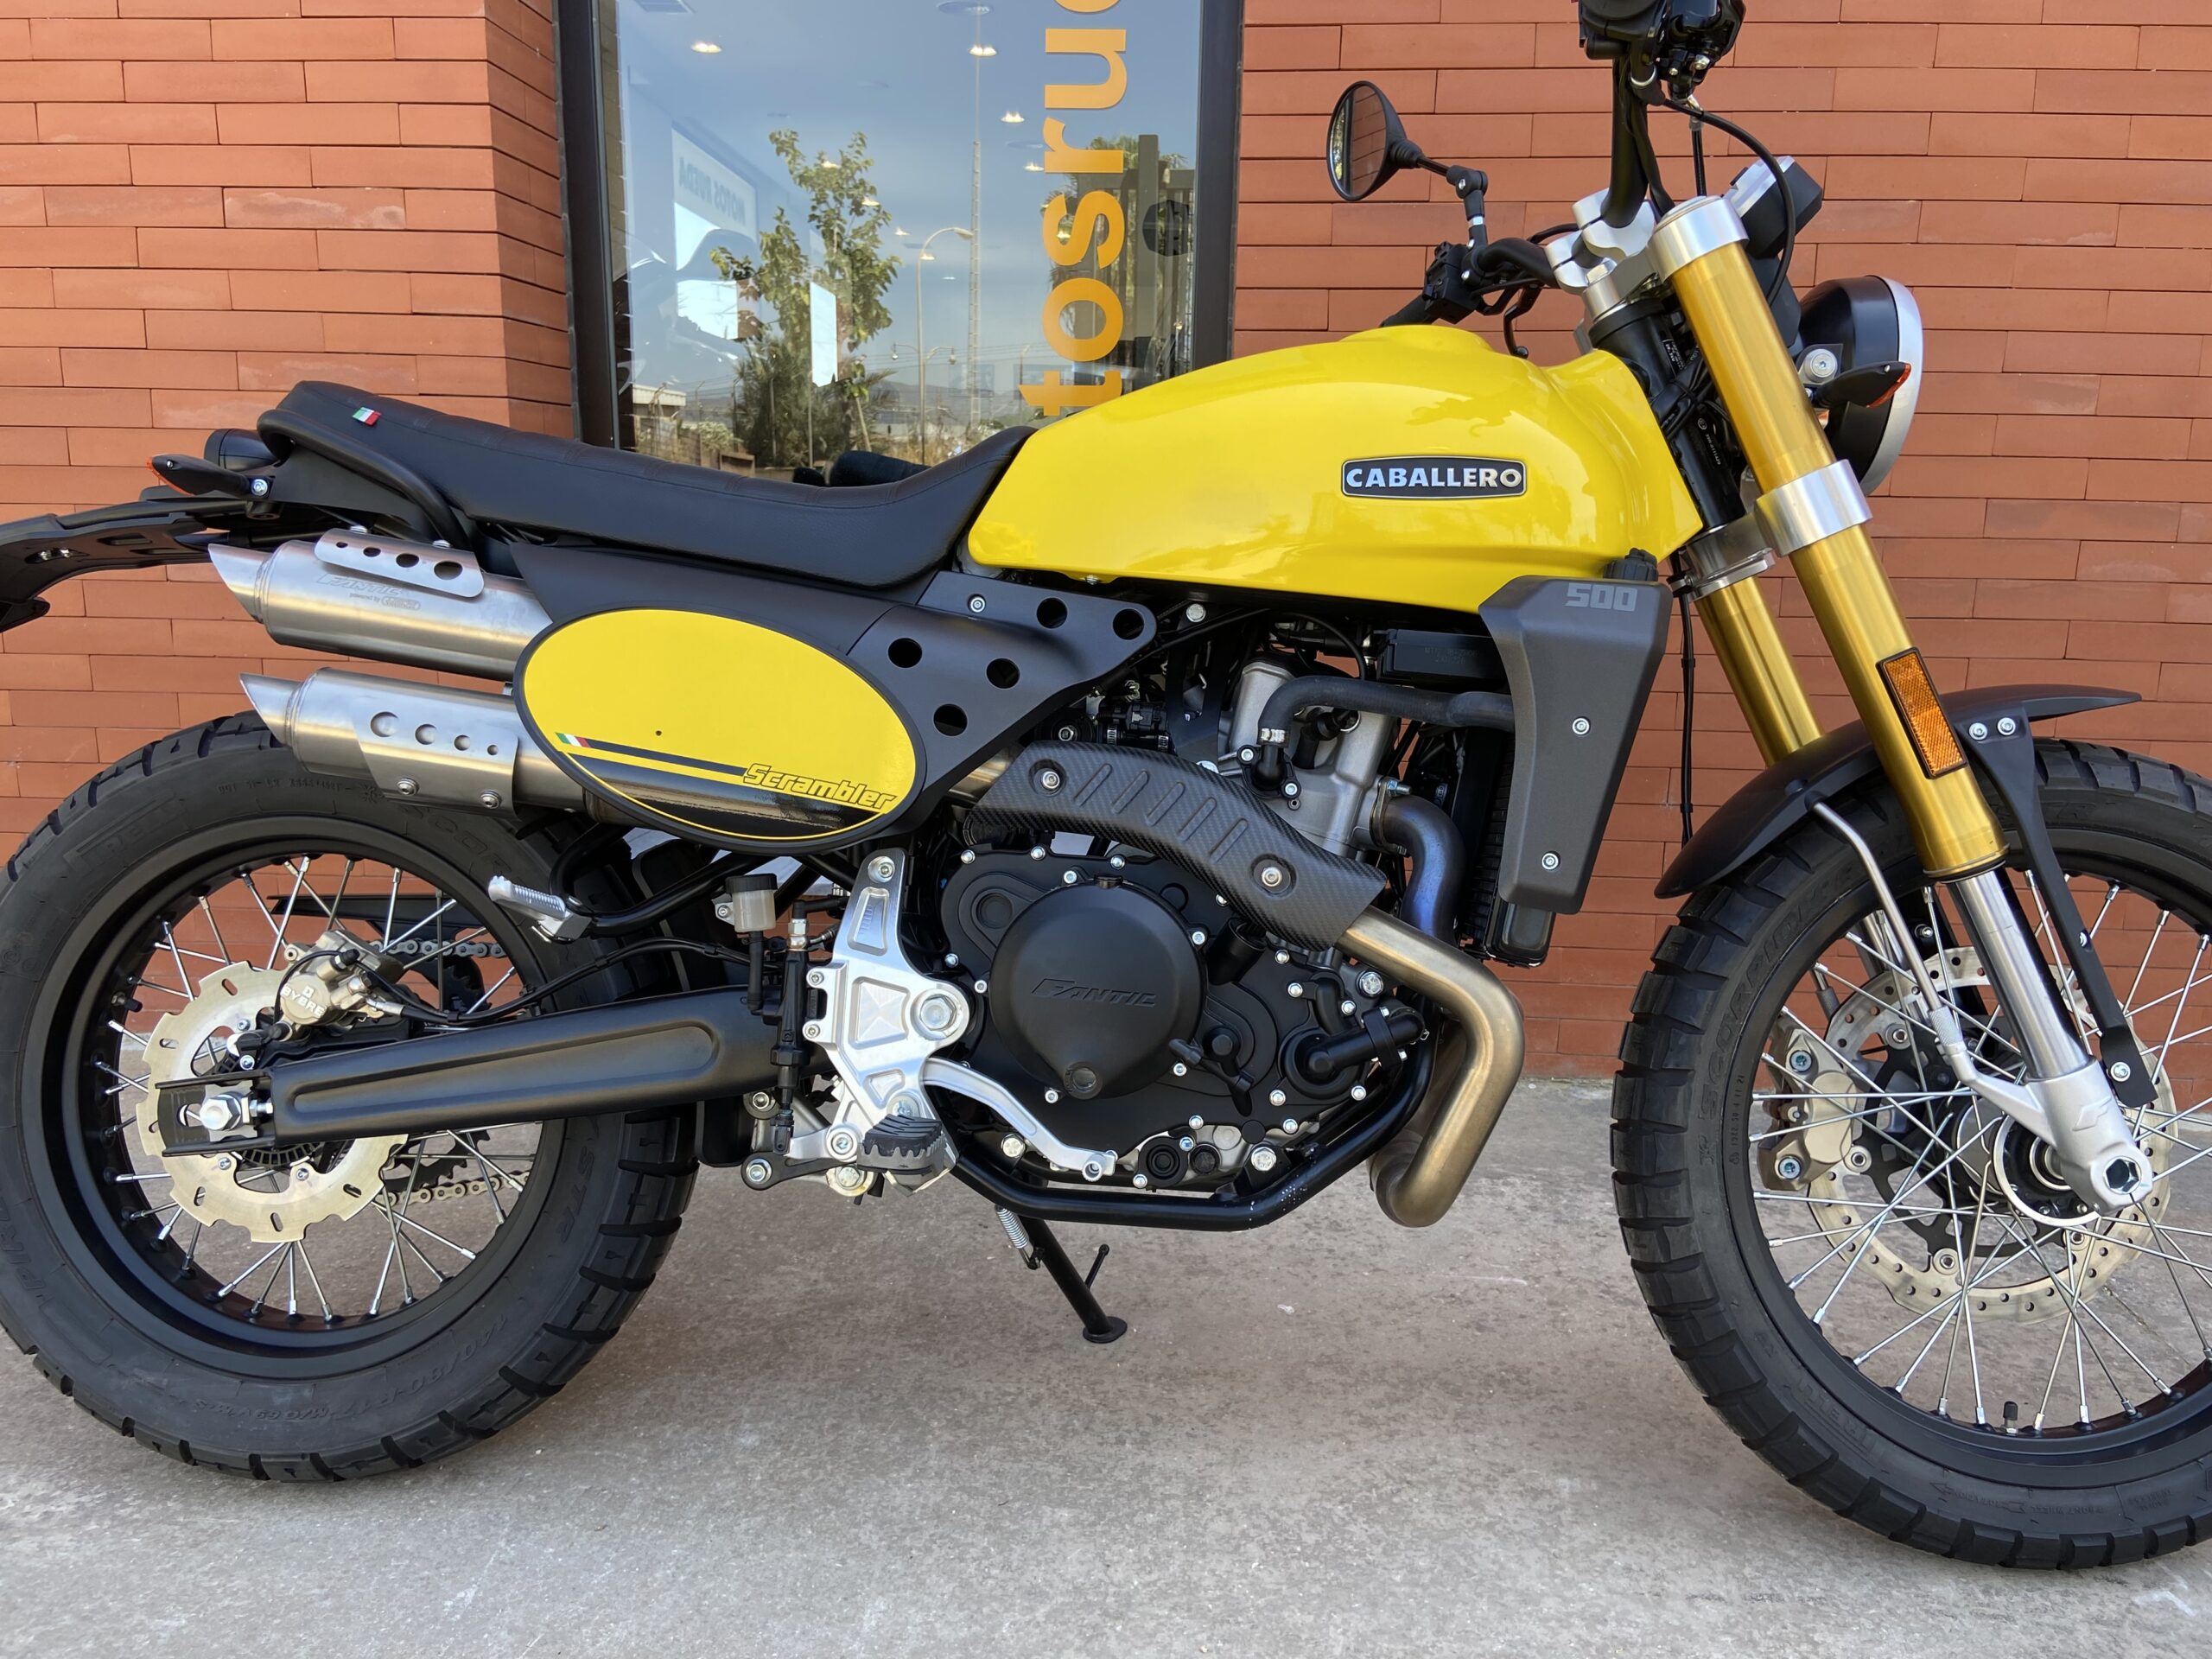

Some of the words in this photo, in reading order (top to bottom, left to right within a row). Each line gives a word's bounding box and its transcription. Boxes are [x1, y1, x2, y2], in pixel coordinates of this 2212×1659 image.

[1018, 0, 1127, 416] tosru
[1345, 467, 1522, 489] CABALLERO
[316, 573, 402, 596] FANTIC
[1564, 582, 1637, 612] 500
[743, 762, 897, 810] Scrambler
[280, 985, 327, 1019] BYBRE
[1032, 977, 1158, 1008] FANTIC
